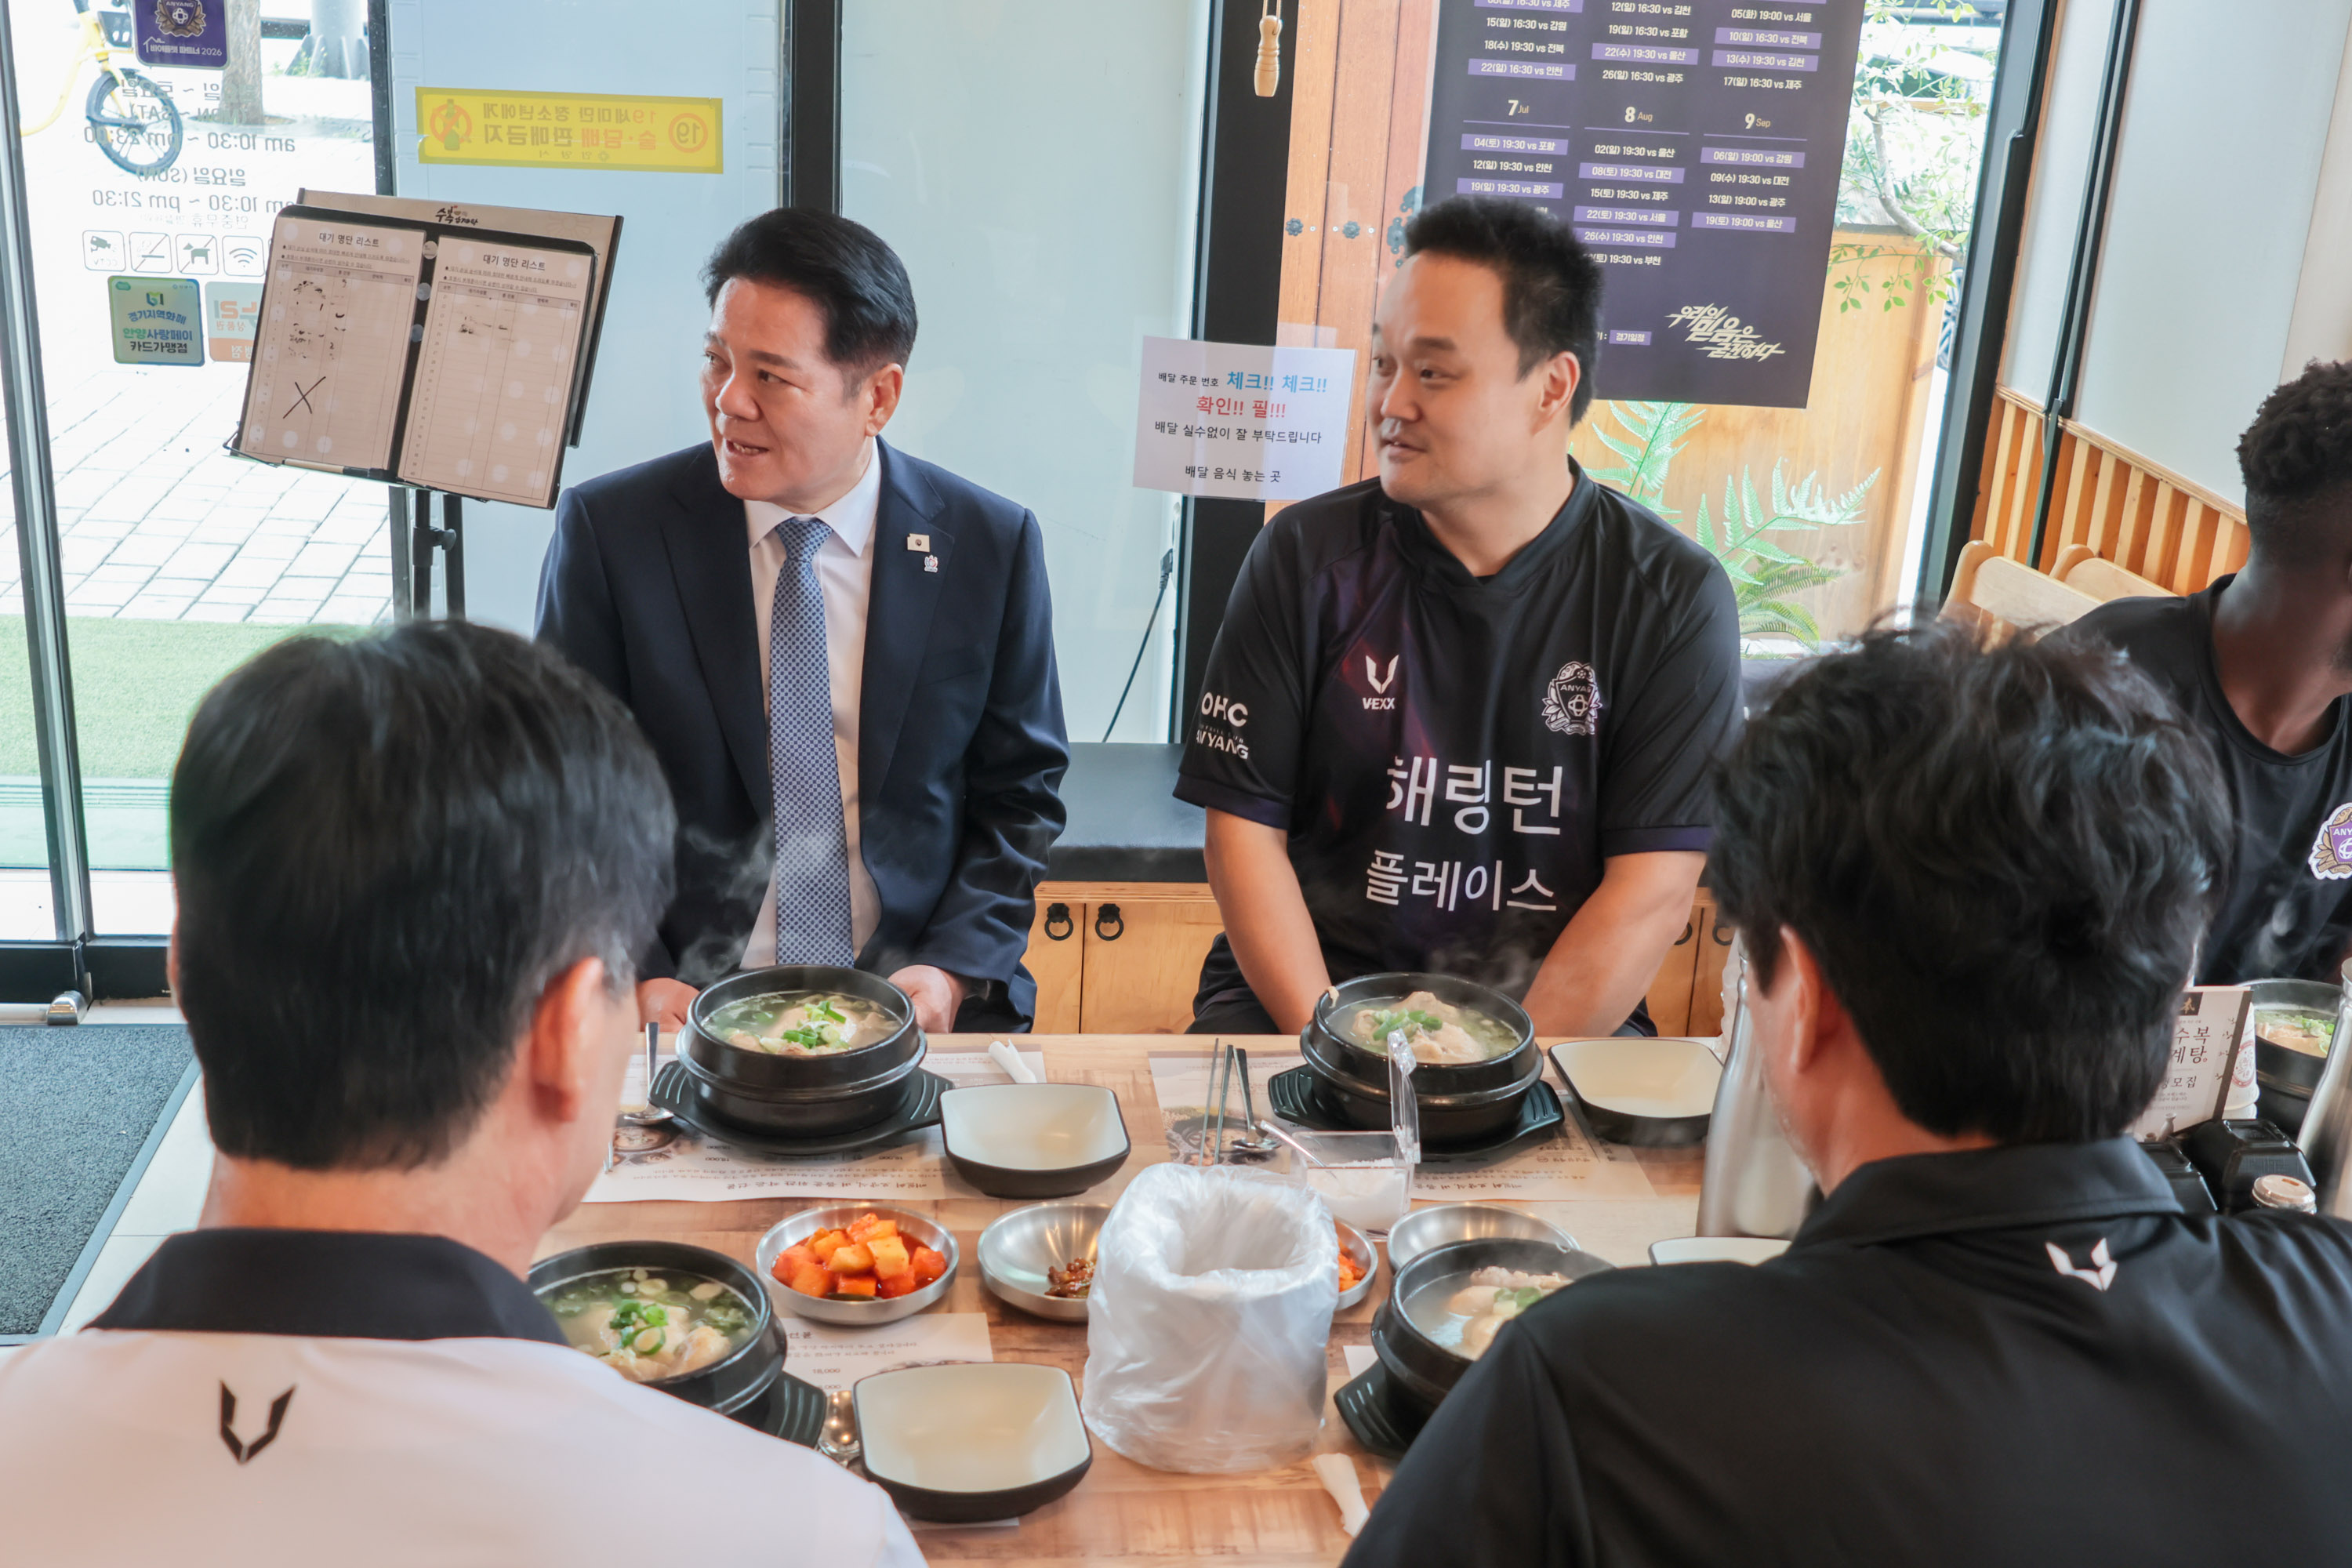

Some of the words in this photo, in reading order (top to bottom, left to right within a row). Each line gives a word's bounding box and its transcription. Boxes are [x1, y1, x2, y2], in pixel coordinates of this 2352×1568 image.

[1612, 2, 1635, 13] 12(일)
[1638, 3, 1661, 14] 16:30
[1674, 5, 1691, 16] 김천
[1731, 9, 1757, 20] 05(화)
[1759, 10, 1782, 20] 19:00
[1795, 13, 1812, 23] 서울
[1486, 17, 1511, 28] 15(일)
[1513, 19, 1537, 30] 16:30
[1538, 22, 1548, 31] vs
[1550, 21, 1567, 31] 강원
[1609, 24, 1632, 35] 19(일)
[1635, 26, 1658, 37] 16:30
[1671, 27, 1689, 38] 포항
[1730, 31, 1753, 42] 10(일)
[1755, 33, 1778, 43] 16:30
[1791, 34, 1808, 45] 전북
[201, 47, 223, 56] 2026
[1484, 40, 1508, 50] 18(수)
[1511, 42, 1534, 52] 19:30
[1548, 44, 1565, 54] 전북
[1605, 47, 1630, 58] 22(수)
[1633, 49, 1656, 59] 19:30
[1669, 50, 1686, 60] 울산
[1726, 54, 1750, 64] 13(수)
[1752, 56, 1775, 66] 19:30
[1788, 57, 1805, 67] 김천
[1481, 63, 1507, 74] 22(일)
[1509, 64, 1533, 74] 16:30
[1546, 66, 1563, 76] 인천
[1508, 100, 1519, 116] 7
[1518, 105, 1529, 114] Jul
[1624, 106, 1635, 123] 8
[1637, 111, 1653, 122] Aug
[1744, 113, 1755, 129] 9
[1756, 118, 1771, 129] Sep
[1474, 138, 1500, 148] 04(토)
[1502, 140, 1525, 150] 19:30
[1538, 141, 1555, 151] 포항
[1595, 144, 1621, 155] 02(일)
[1622, 146, 1646, 156] 19:30
[1658, 147, 1675, 158] 울산
[1473, 160, 1497, 170] 12(일)
[1499, 162, 1523, 172] 19:30
[1535, 163, 1552, 173] 인천
[1592, 166, 1617, 176] 08(토)
[1620, 168, 1642, 178] 19:30
[1655, 169, 1671, 180] 대전
[1710, 172, 1736, 183] 09(수)
[1738, 174, 1761, 185] 19:30
[1773, 176, 1790, 186] 대전
[1471, 182, 1495, 192] 19(일)
[1497, 183, 1520, 194] 19:30
[1533, 184, 1549, 194] 광주
[1591, 188, 1614, 198] 15(토)
[1617, 190, 1639, 200] 19:30
[1651, 191, 1668, 201] 제주
[1708, 194, 1732, 205] 13(일)
[1734, 196, 1757, 206] 19:00
[1769, 198, 1786, 208] 광주
[1586, 209, 1612, 220] 22(토)
[1614, 211, 1637, 221] 19:30
[1650, 212, 1666, 223] 서울
[1706, 216, 1729, 226] 19(토)
[1731, 217, 1754, 227] 19:00
[1766, 219, 1783, 229] 울산
[319, 232, 335, 243] 대기
[338, 234, 353, 245] 명단
[356, 237, 379, 248] 리스트
[1584, 231, 1610, 241] 26(수)
[1612, 233, 1634, 243] 19:30
[1647, 234, 1664, 245] 인천
[483, 254, 499, 265] 대기
[503, 256, 519, 268] 명단
[521, 260, 546, 271] 리스트
[128, 309, 187, 325] 경기지역화폐
[1664, 302, 1729, 328] 우리의
[123, 327, 193, 341] 안양사랑페이
[1685, 314, 1762, 343] 믿음은
[130, 341, 187, 354] 카드가맹점
[1695, 341, 1786, 362] 굳건하다
[1158, 372, 1176, 383] 배달
[1180, 375, 1197, 386] 주문
[1201, 376, 1219, 387] 번호
[1227, 371, 1274, 390] 체크!!
[1281, 374, 1327, 393] 체크!!
[1196, 396, 1244, 416] 확인!!
[1252, 399, 1286, 419] 필!!!
[1155, 420, 1178, 434] 배달
[1183, 424, 1230, 440] 실수없이
[1236, 428, 1247, 441] 잘
[1252, 430, 1322, 445] 부탁드립니다
[1185, 466, 1209, 478] 배달
[1214, 467, 1236, 480] 음식
[1241, 469, 1265, 482] 놓는
[1270, 470, 1281, 483] 곳
[1201, 691, 1248, 728] OHC
[1363, 697, 1396, 710] VEXX
[1386, 756, 1563, 835] 해링턴
[1365, 849, 1557, 912] 플레이스
